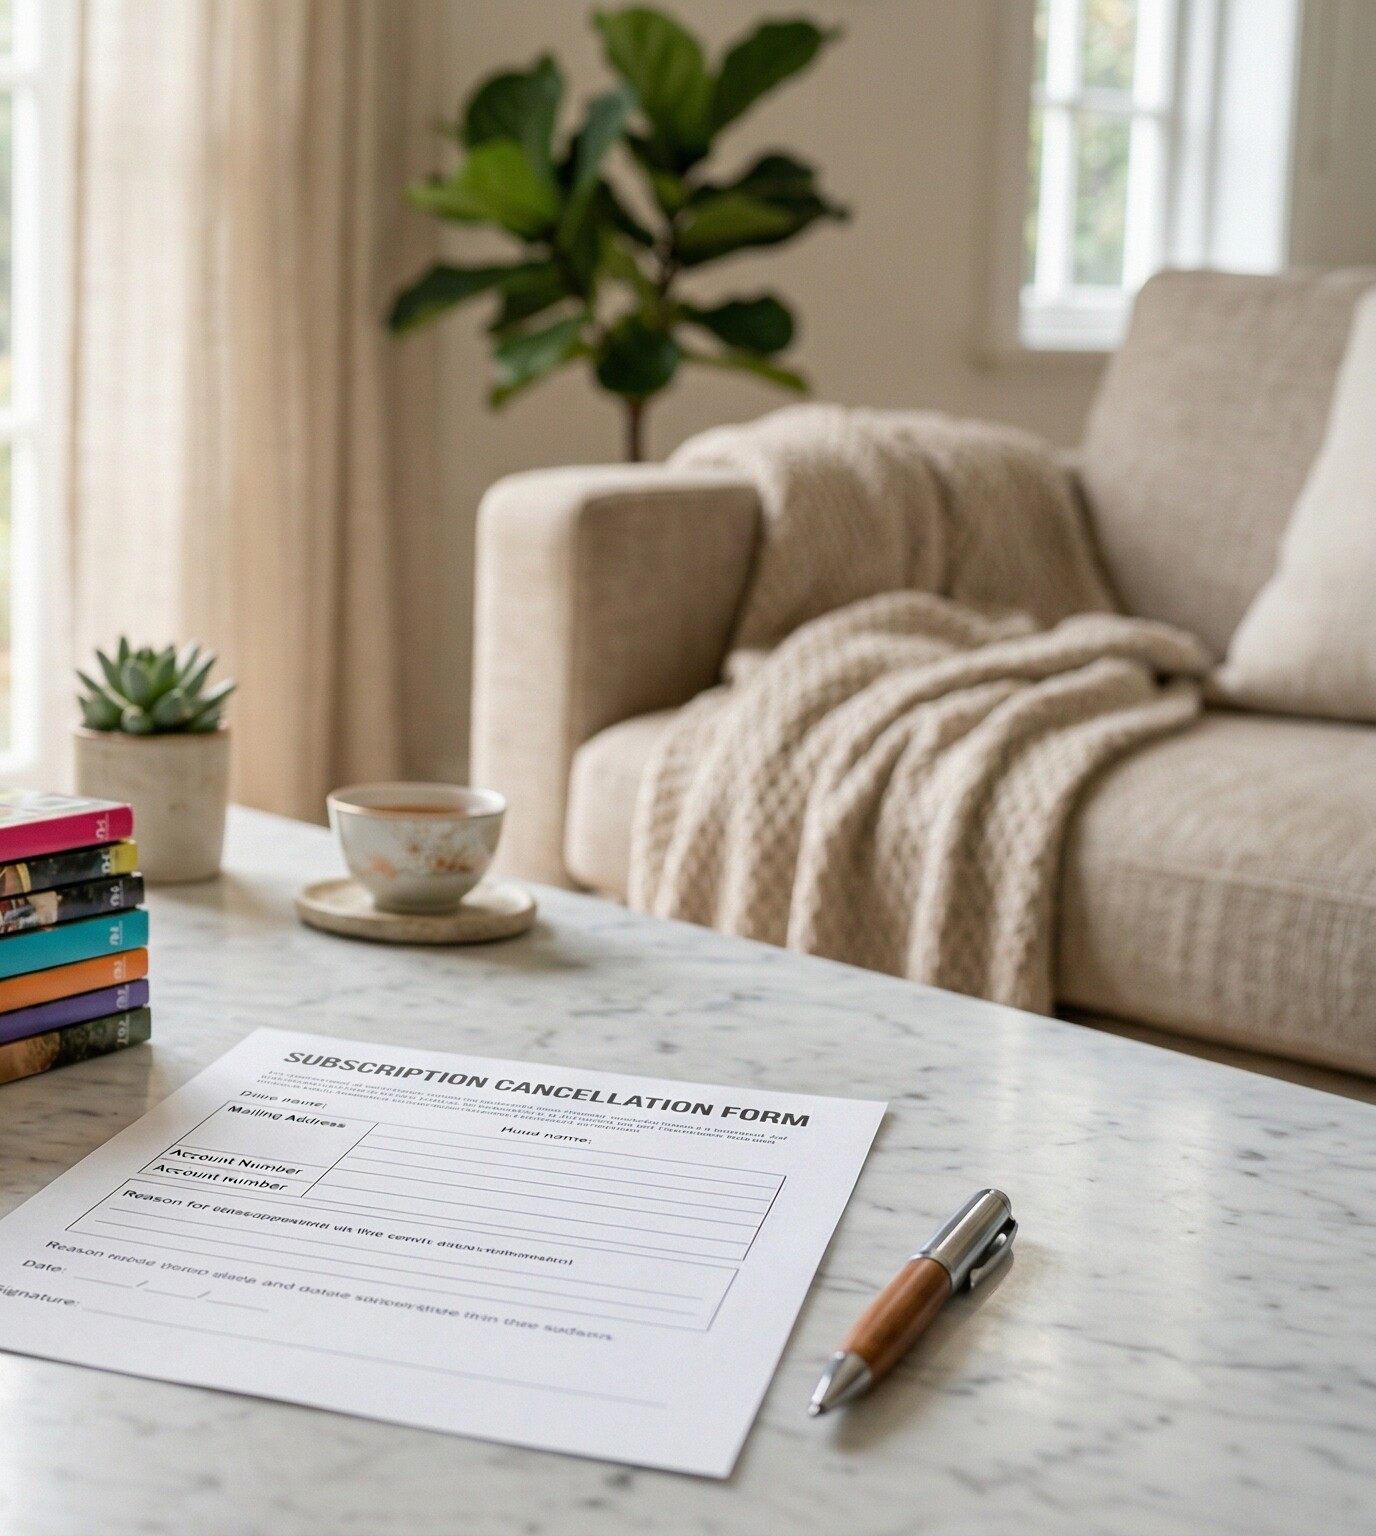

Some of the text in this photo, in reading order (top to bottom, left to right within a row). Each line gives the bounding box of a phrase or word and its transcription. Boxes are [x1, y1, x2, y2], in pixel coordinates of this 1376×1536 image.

[283, 1051, 489, 1089] SUBSCRIPTION
[493, 1079, 714, 1117] CANCELLATION
[720, 1106, 811, 1128] FORM
[285, 1113, 347, 1129] Address
[169, 1148, 304, 1176] Account Number
[153, 1164, 220, 1182] Account
[122, 1189, 211, 1211] Reason for
[45, 1240, 105, 1258] Reason
[22, 1259, 68, 1274] Date:
